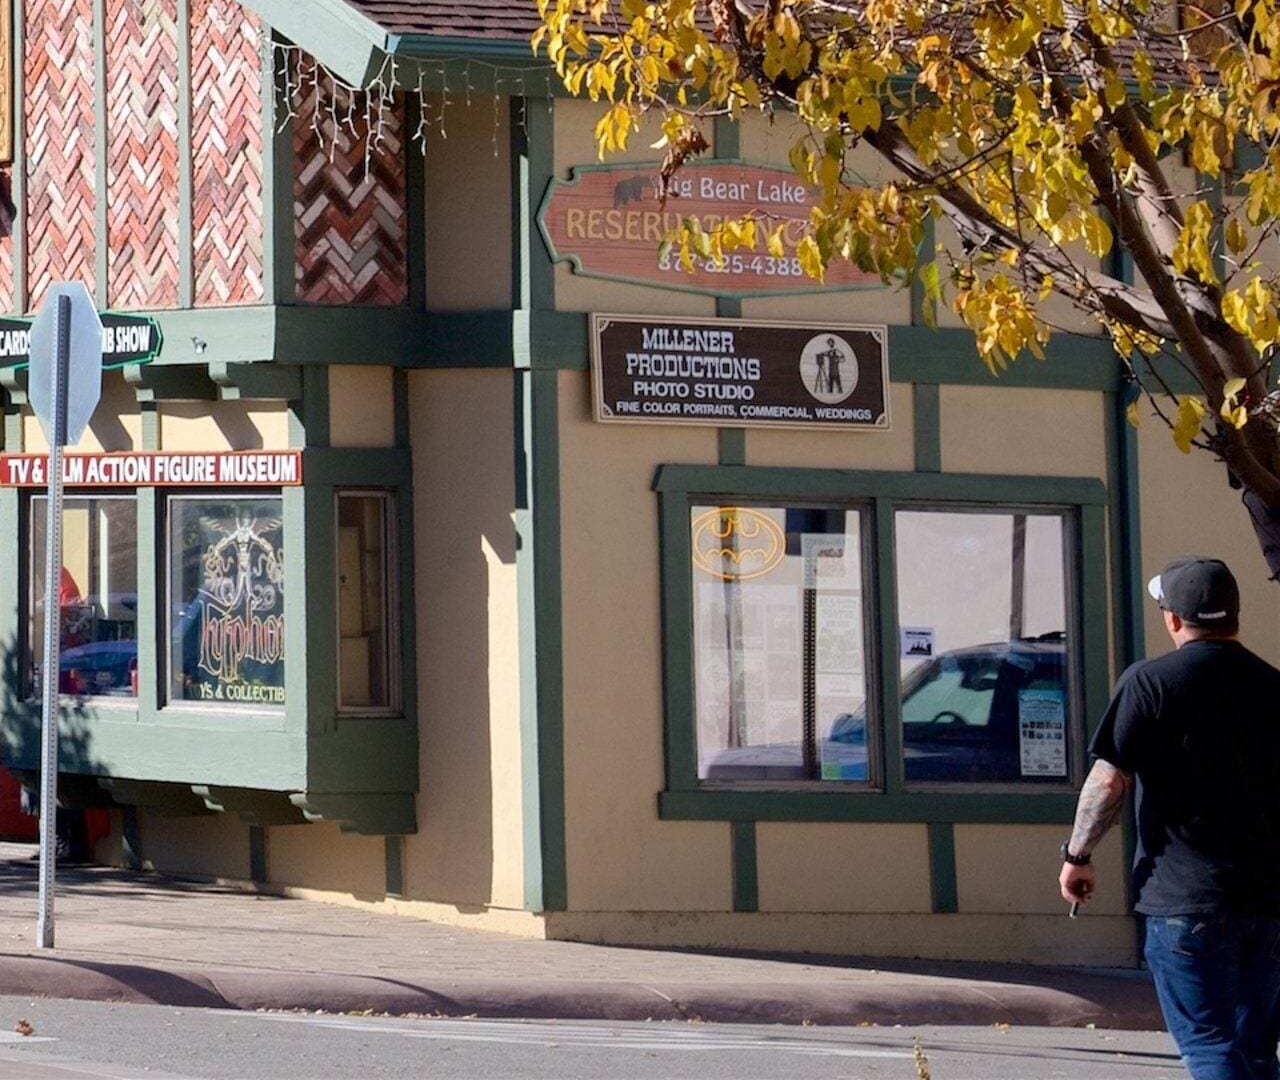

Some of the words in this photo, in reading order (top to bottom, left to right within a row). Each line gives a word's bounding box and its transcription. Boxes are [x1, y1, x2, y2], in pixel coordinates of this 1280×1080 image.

[699, 176, 750, 201] Bear
[756, 179, 806, 204] Lake
[116, 325, 151, 353] SHOW
[641, 327, 736, 354] MILLENER
[625, 352, 761, 381] PRODUCTIONS
[633, 381, 690, 398] PHOTO
[694, 383, 755, 401] STUDIO
[616, 400, 640, 413] FINE
[643, 402, 681, 414] COLOR
[683, 403, 738, 417] PORTRAITS,
[740, 404, 813, 419] COMMERCIAL,
[815, 407, 872, 420] WEDDINGS
[7, 458, 30, 483] TV
[31, 458, 44, 483] &
[85, 456, 150, 483] ACTION
[153, 455, 217, 482] FIGURE
[219, 455, 297, 482] MUSEUM
[214, 684, 225, 699] &
